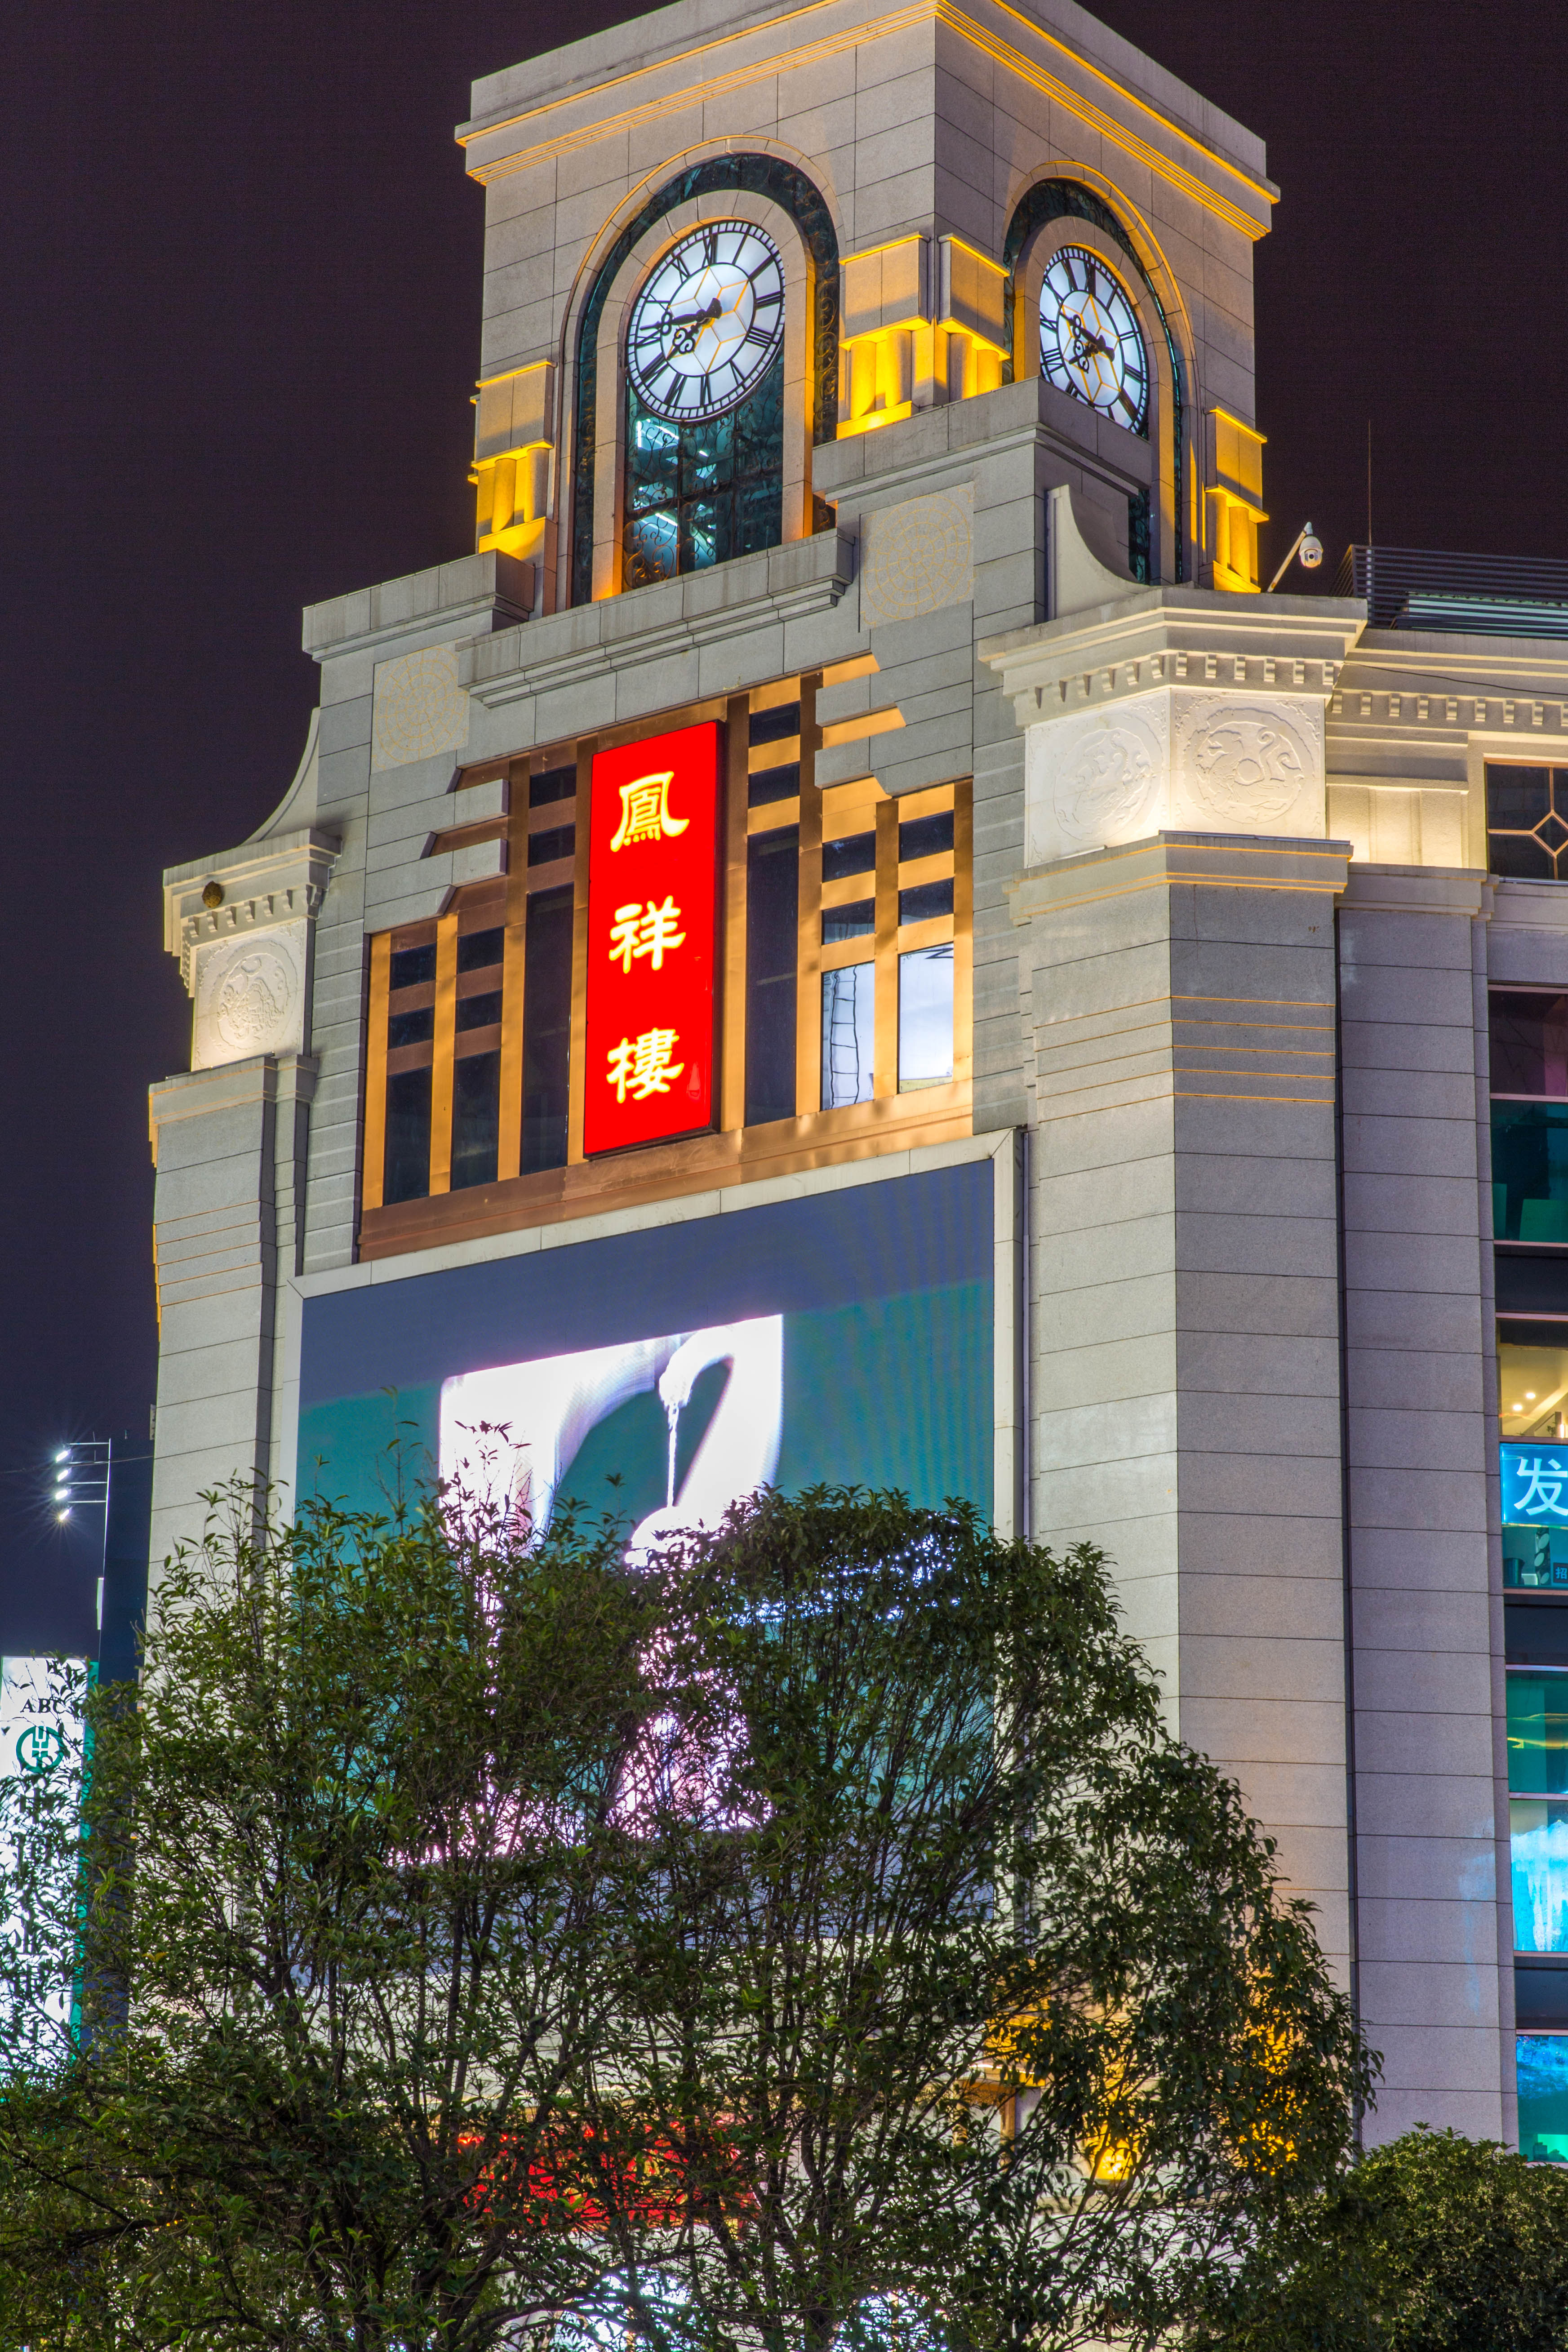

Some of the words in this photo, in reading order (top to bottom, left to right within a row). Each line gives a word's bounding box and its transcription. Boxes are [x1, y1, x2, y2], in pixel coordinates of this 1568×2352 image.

[607, 771, 690, 1103] 鳳祥樓
[1513, 1458, 1568, 1516] 发
[1555, 1566, 1567, 1579] 招
